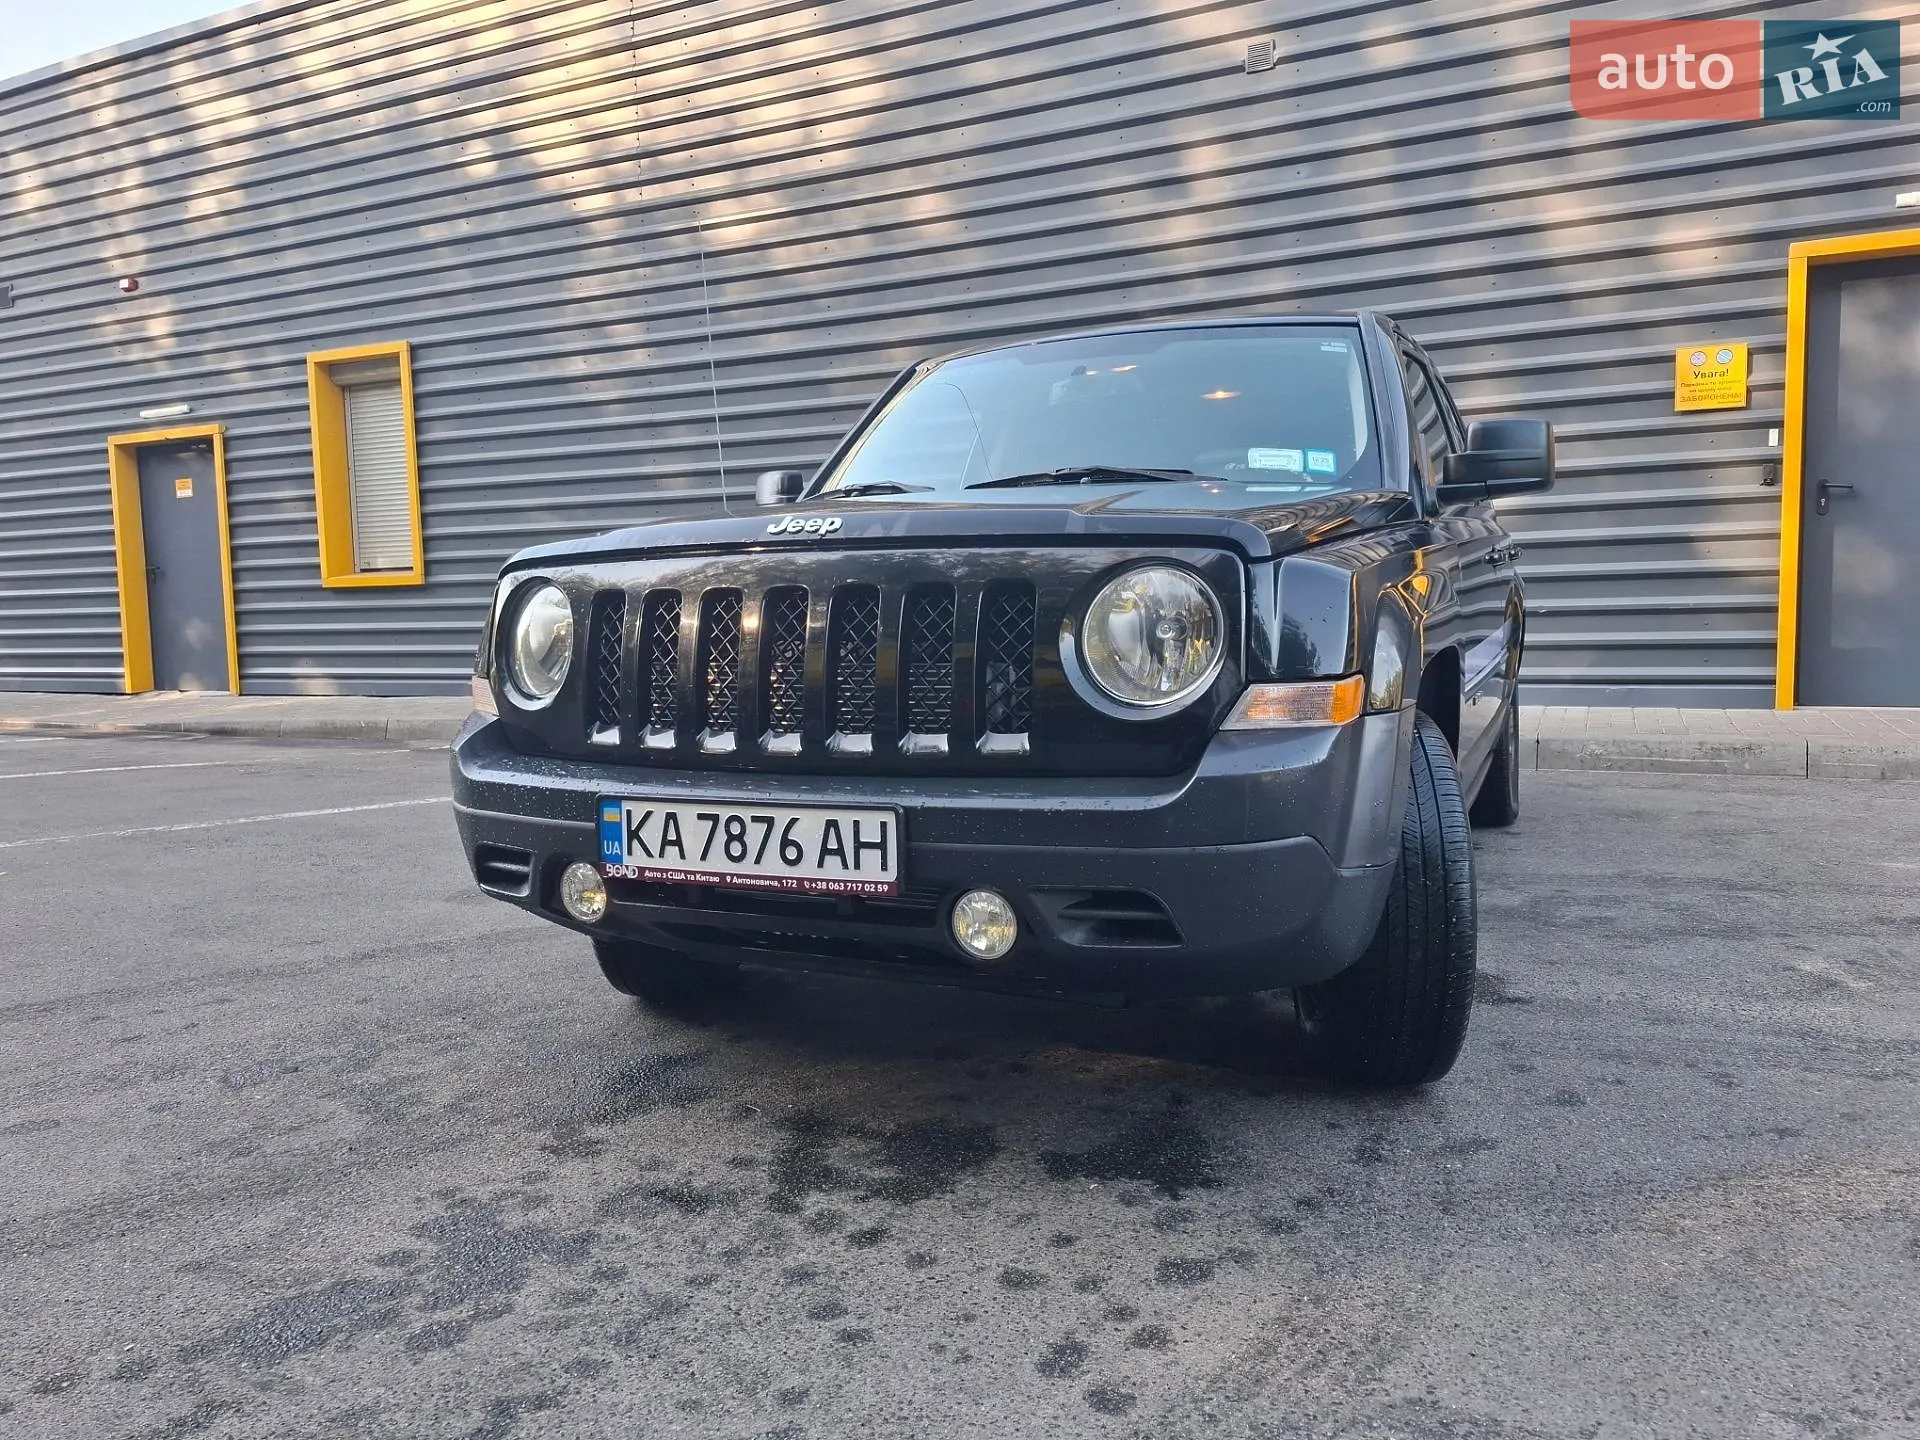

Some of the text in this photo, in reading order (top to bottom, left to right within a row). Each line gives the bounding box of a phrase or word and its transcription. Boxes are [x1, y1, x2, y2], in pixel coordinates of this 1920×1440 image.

[1693, 368, 1729, 379] Увага!
[1680, 391, 1742, 403] ЗАБОРОНЕНА!
[766, 515, 843, 537] Jeep
[625, 807, 889, 872] KA 7876 AH
[604, 839, 622, 856] UA
[644, 869, 662, 878] Авто
[667, 871, 686, 880] США
[687, 873, 695, 881] та
[695, 873, 720, 883] Китаю
[782, 879, 798, 888] 172
[811, 881, 889, 892] +38 063 717 02 59
